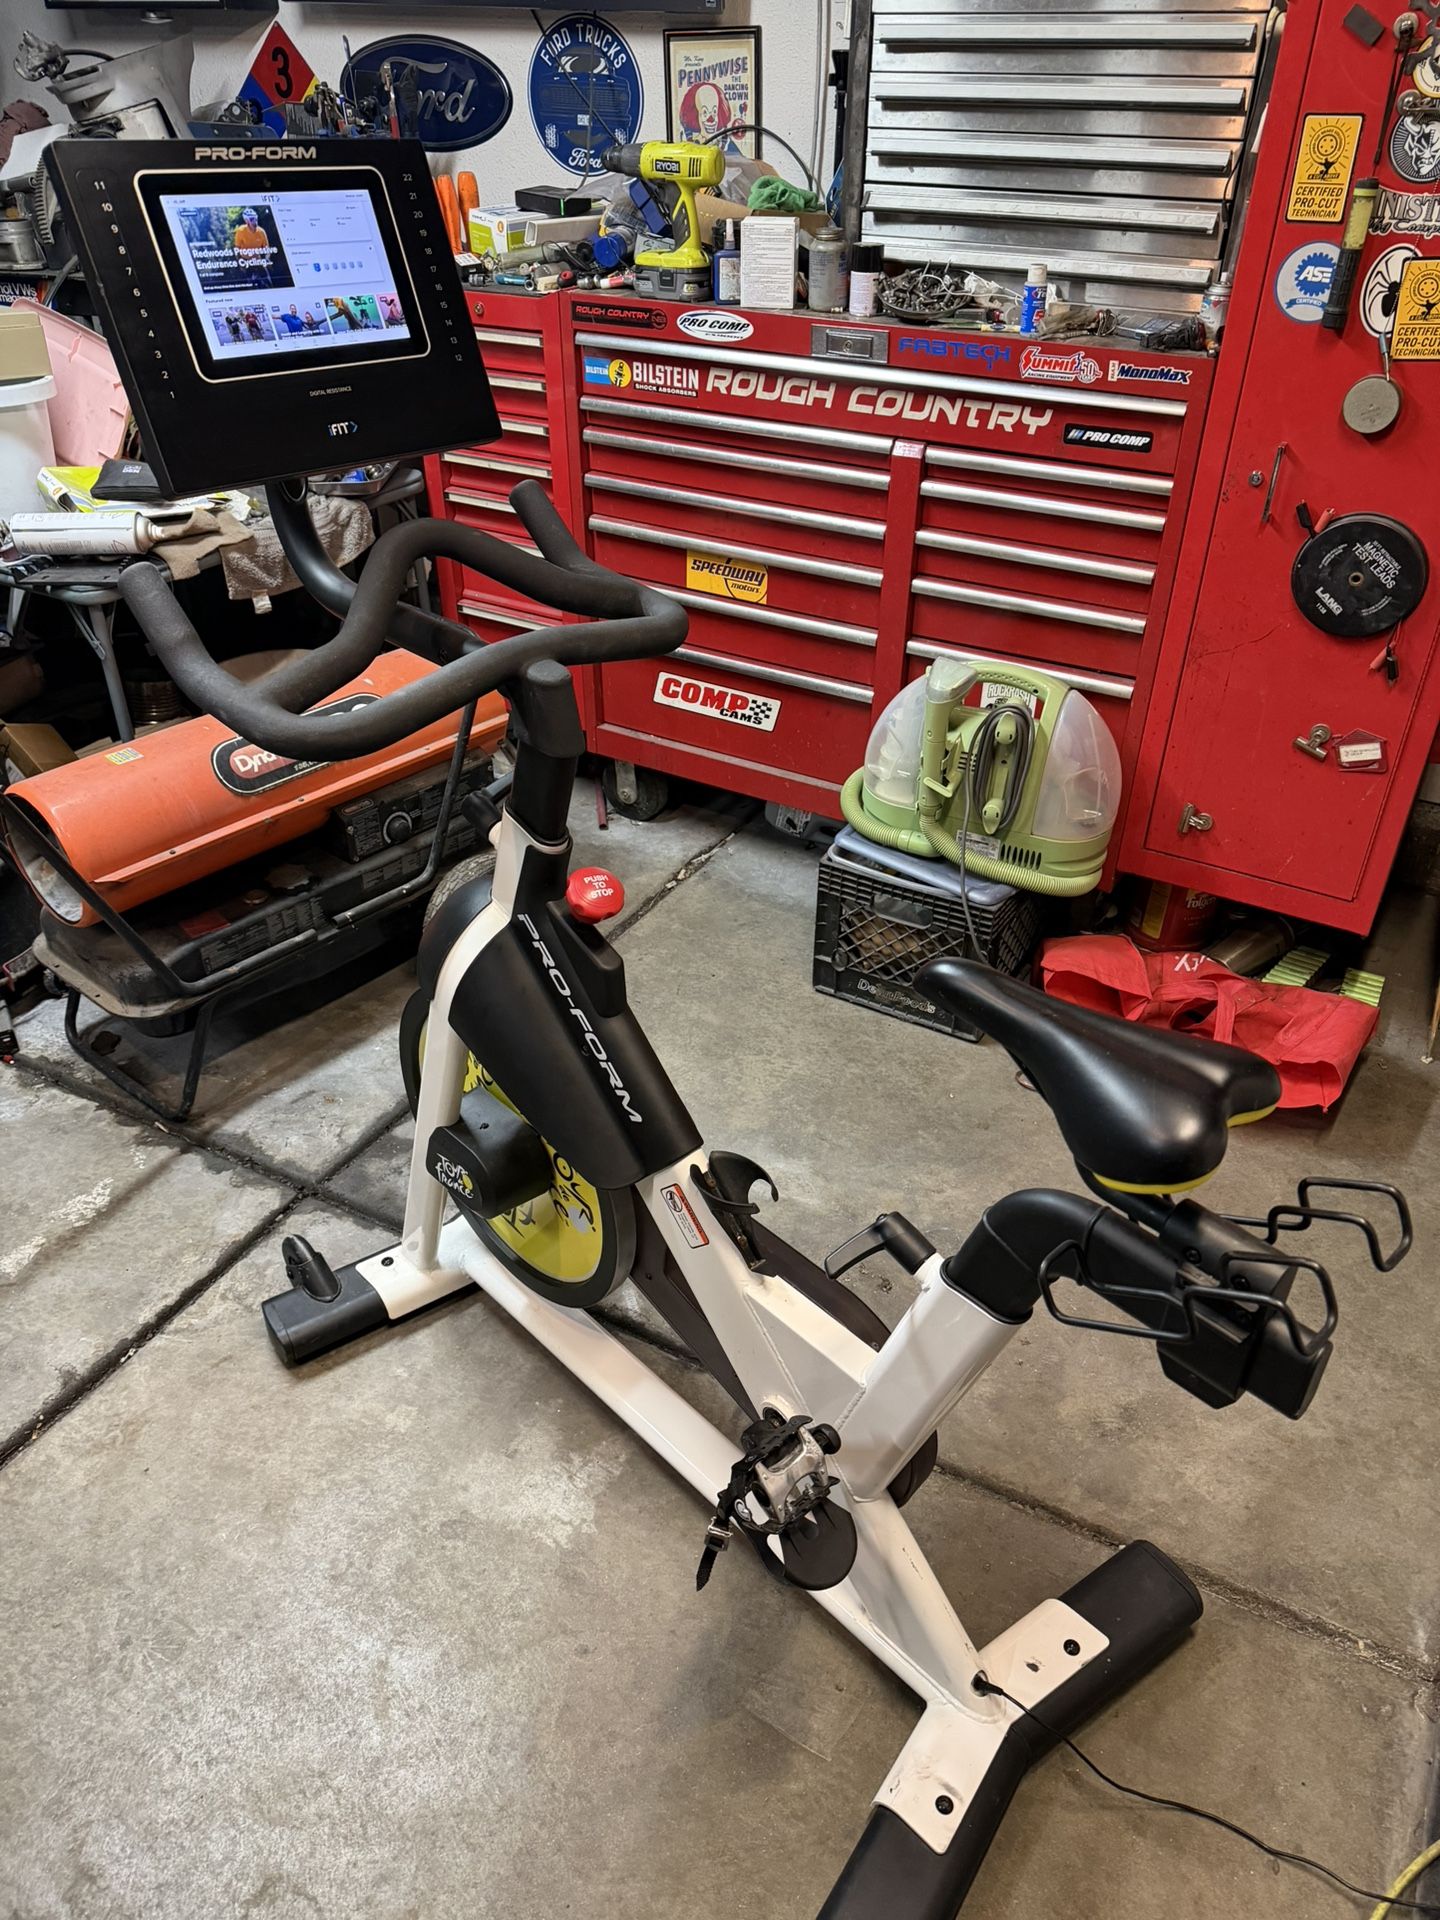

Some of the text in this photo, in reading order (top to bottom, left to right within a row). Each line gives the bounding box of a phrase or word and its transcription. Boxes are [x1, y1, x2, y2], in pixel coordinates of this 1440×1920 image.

[575, 23, 627, 69] TRUCKS
[271, 46, 294, 99] 3
[678, 56, 748, 89] PENNYWISE
[731, 75, 742, 83] THE
[724, 83, 749, 91] DANCING
[724, 91, 749, 101] CLOWN
[194, 146, 317, 161] PRO-FORM
[655, 159, 681, 173] RYOBI
[402, 174, 413, 182] 22
[94, 181, 106, 191] 11
[409, 192, 417, 200] 21
[1295, 186, 1344, 197] CERTIFIED
[101, 203, 113, 212] 10
[1293, 197, 1340, 209] PRO-CUT
[413, 211, 424, 219] 20
[1291, 208, 1338, 218] TECHNICIAN
[110, 224, 119, 234] 9
[419, 229, 428, 237] 19
[118, 245, 127, 255] 8
[192, 247, 233, 259] Redwoods
[233, 245, 278, 258] Progressive
[424, 247, 433, 255] 18
[194, 259, 237, 270] Endurance
[430, 265, 437, 273] 17
[125, 267, 133, 277] 7
[1300, 265, 1333, 283] ASE
[132, 287, 142, 297] 6
[435, 283, 443, 292] 16
[439, 301, 448, 309] 15
[1295, 297, 1323, 307] CERTIFIED
[140, 308, 148, 318] 5
[575, 305, 605, 315] ROUGH
[607, 309, 649, 320] COUNTRY
[445, 319, 453, 327] 14
[680, 317, 751, 331] PRO COMP
[148, 329, 155, 339] 4
[1397, 326, 1440, 337] CERTIFIE
[450, 336, 458, 344] 13
[154, 350, 162, 360] 3
[455, 354, 463, 362] 12
[898, 337, 1011, 370] FABTECH
[585, 364, 609, 374] BILSTEIN
[1081, 361, 1095, 376] 50
[161, 370, 169, 380] 2
[632, 361, 699, 390] BILSTEIN
[1117, 364, 1190, 384] MonoMax
[169, 390, 175, 399] 1
[309, 385, 352, 397] DIGITAL RESISTANCE
[635, 382, 697, 397] SHOCK ABSORBERS
[705, 367, 1053, 435] ROUGH COUNTRY
[1082, 430, 1150, 447] PRO COMP
[1363, 541, 1399, 578] MAGNETIC
[1351, 542, 1373, 564] TEST
[1369, 562, 1396, 589] LEADS
[691, 559, 766, 586] SPEEDWAY
[730, 582, 760, 594] motors
[1315, 586, 1343, 616] LANG
[661, 677, 750, 712] COMP
[720, 708, 763, 725] CAMS
[584, 875, 608, 884] PUSH
[593, 881, 607, 889] TO
[590, 888, 614, 899] STOP
[517, 913, 643, 1123] PRO-FORM
